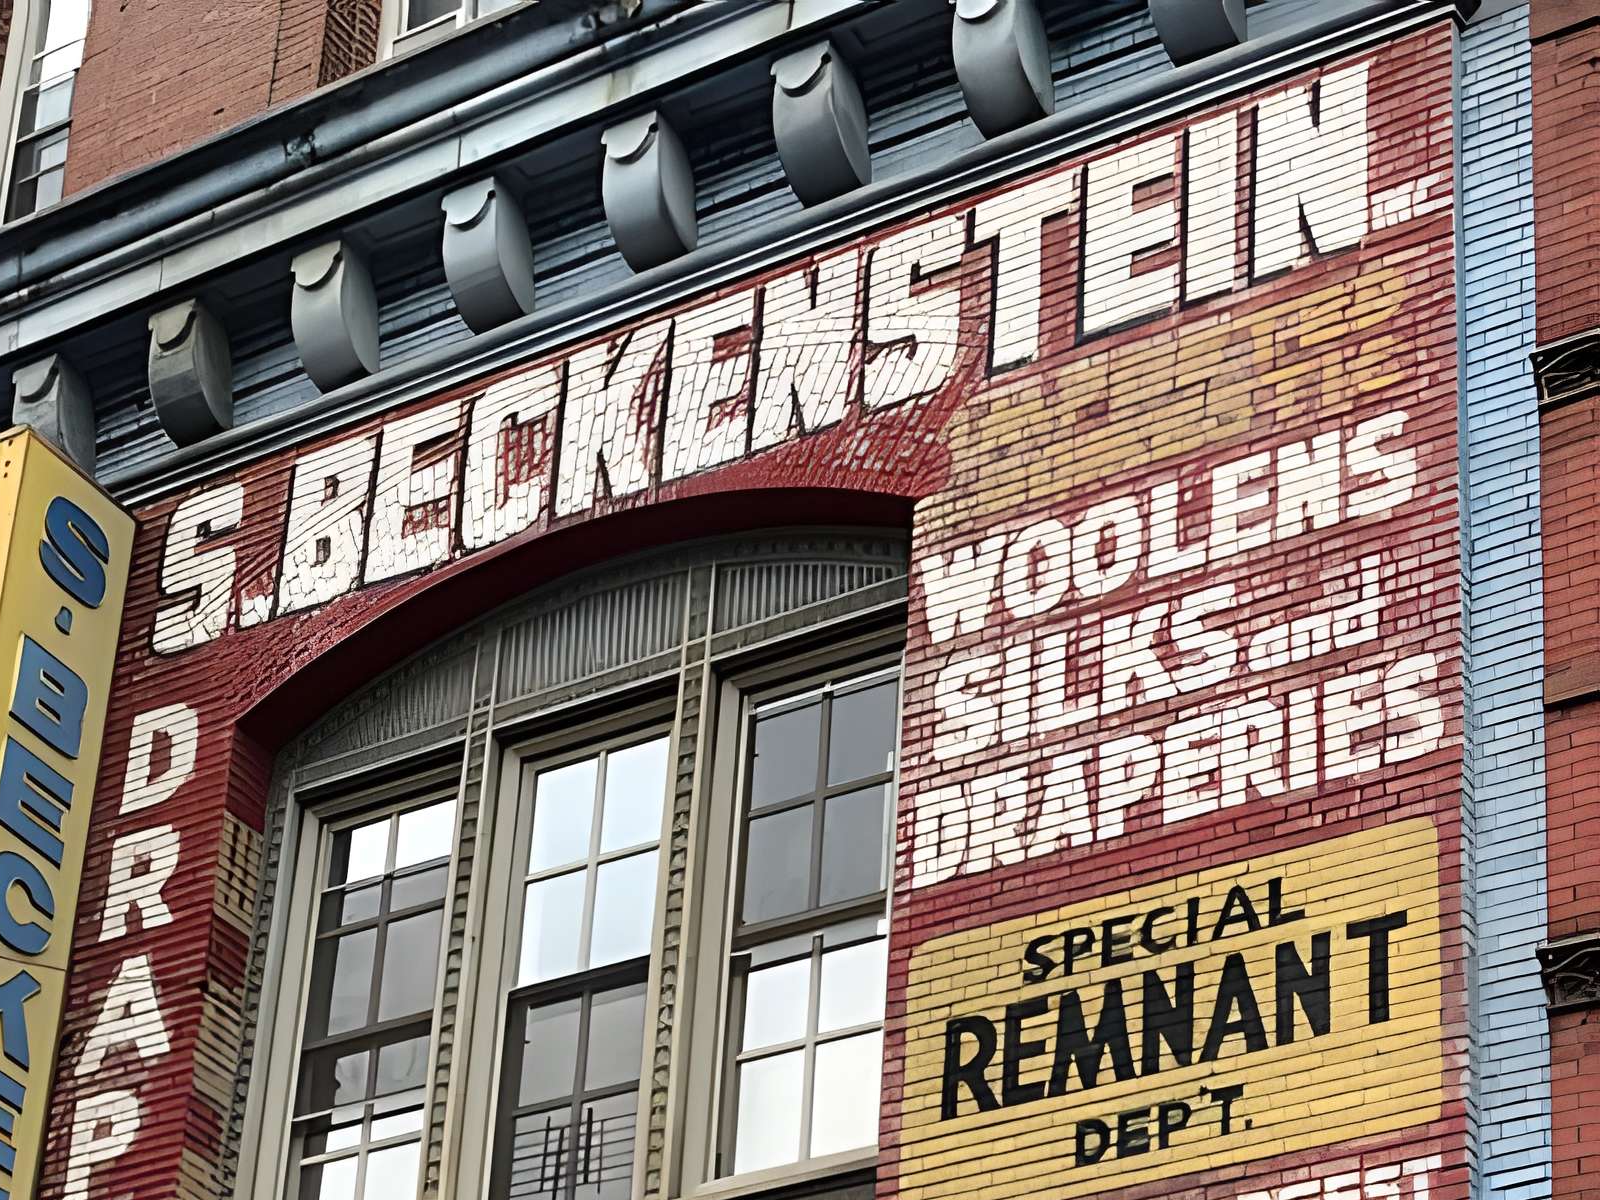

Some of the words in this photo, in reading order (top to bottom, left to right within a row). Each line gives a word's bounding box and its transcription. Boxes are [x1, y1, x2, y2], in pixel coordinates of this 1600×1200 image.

[275, 58, 1370, 615] BECKENSTEIN
[920, 410, 1417, 642] WOOLENS
[912, 652, 1445, 889] DRAPERIES
[934, 582, 1239, 761] SILKS
[940, 910, 1407, 1121] REMNANT
[1022, 876, 1305, 984] SPECIAL
